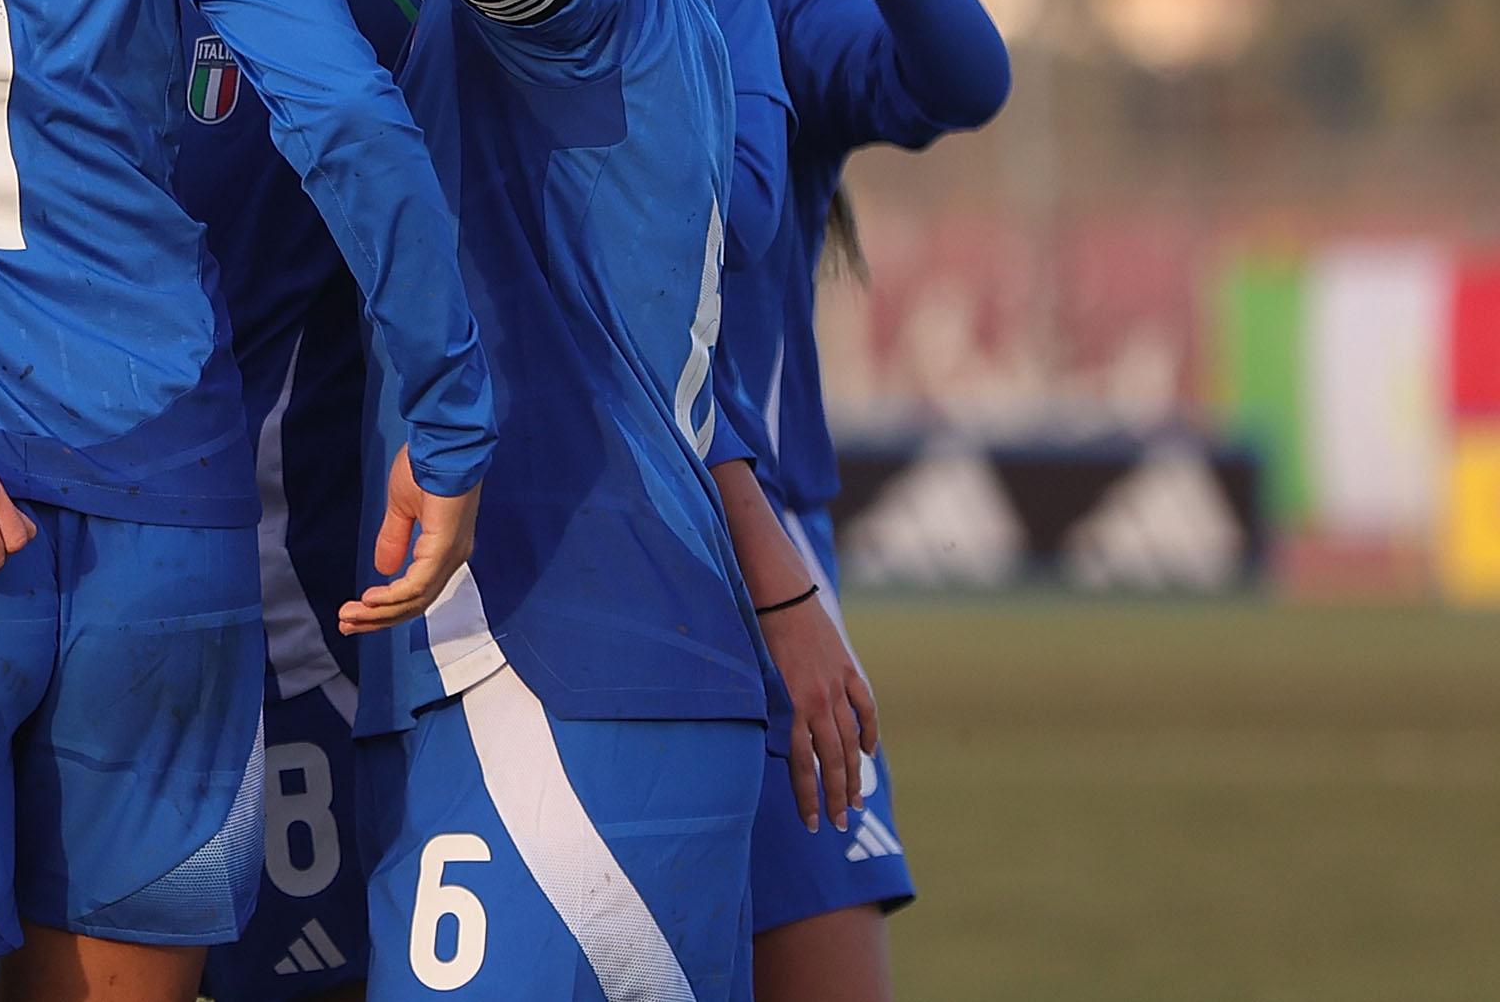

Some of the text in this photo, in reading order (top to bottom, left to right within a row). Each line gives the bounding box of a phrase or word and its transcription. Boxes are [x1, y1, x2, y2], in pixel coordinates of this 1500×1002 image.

[198, 43, 233, 60] ITALI
[264, 742, 341, 897] 8
[409, 832, 492, 991] 6
